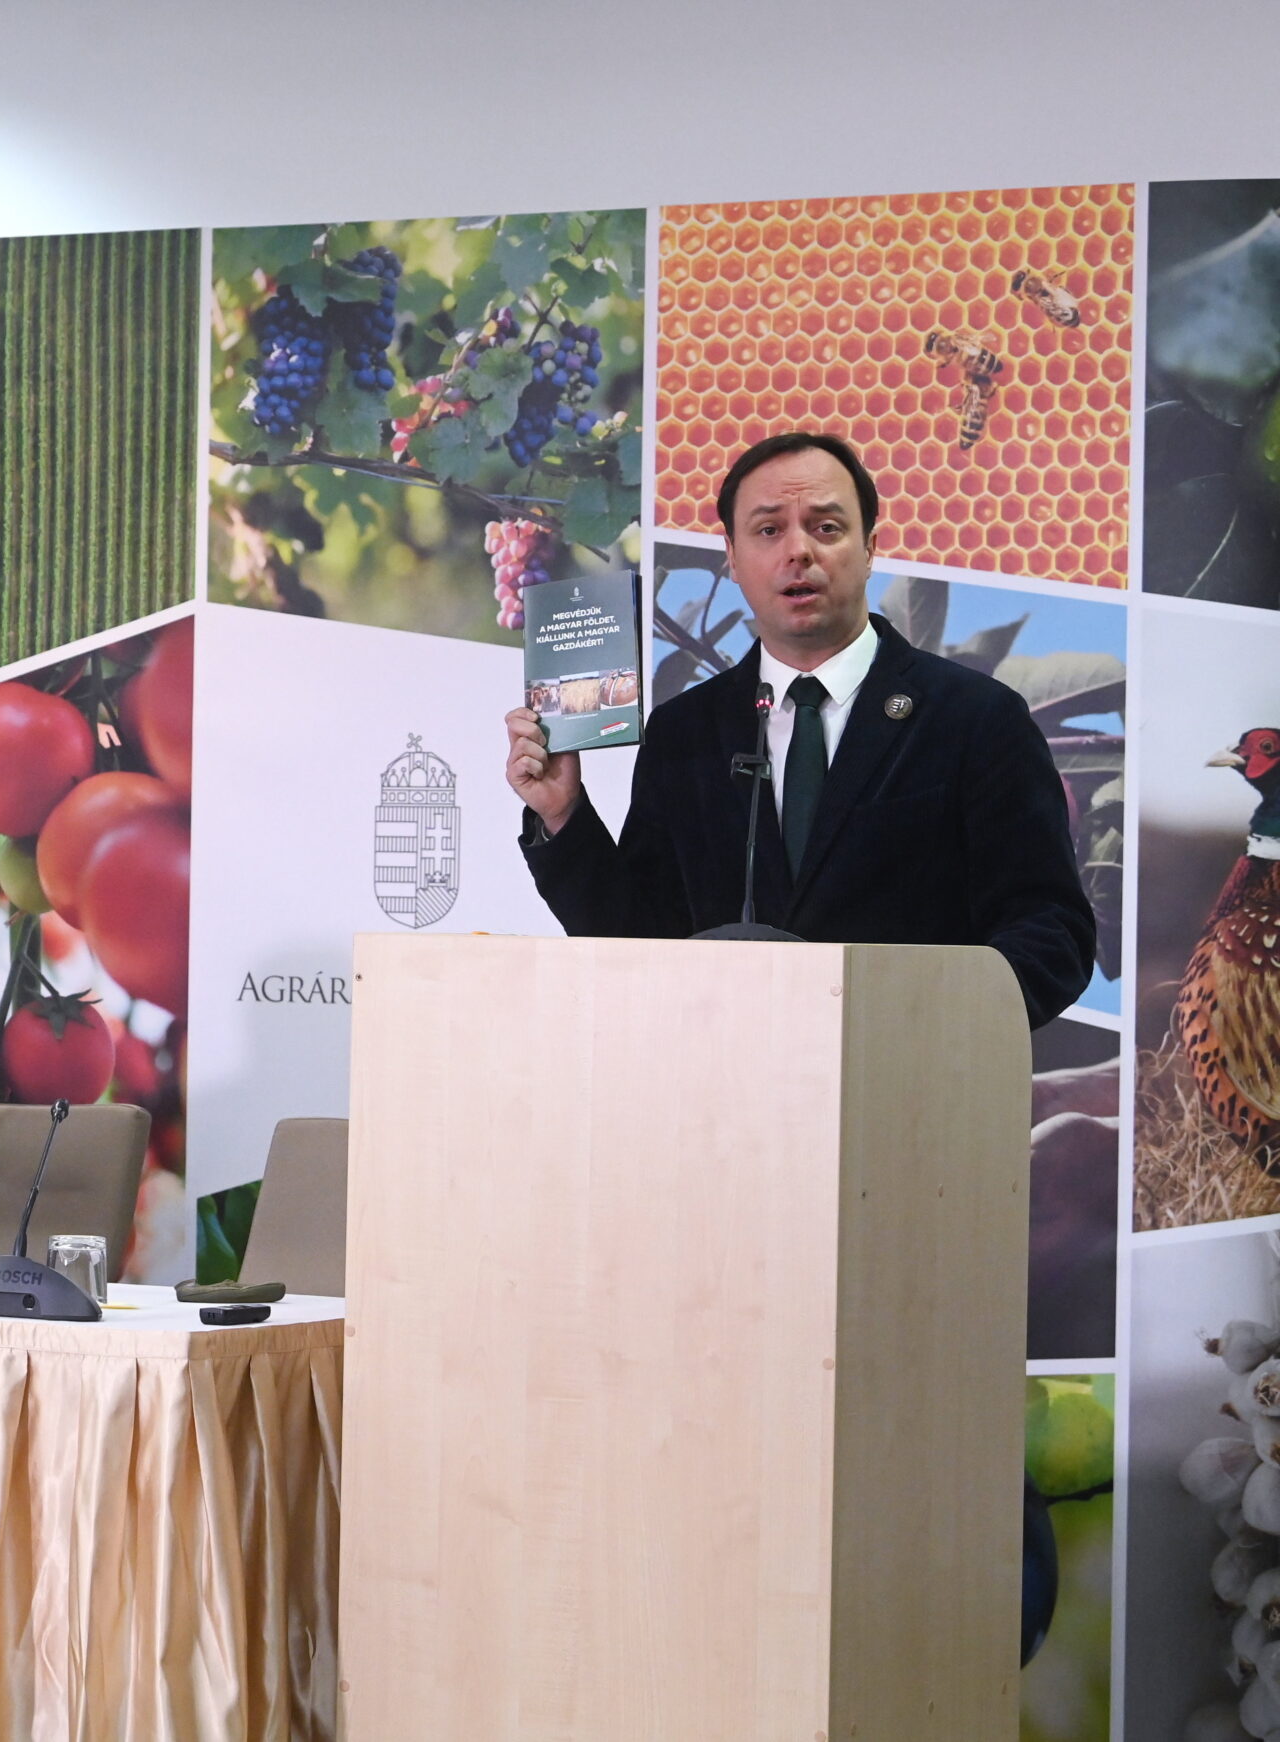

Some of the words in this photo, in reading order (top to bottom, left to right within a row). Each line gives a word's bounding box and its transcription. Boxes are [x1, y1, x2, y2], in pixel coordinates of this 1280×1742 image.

[552, 606, 602, 621] MEGVÉDJÜK
[547, 620, 582, 632] MAGYAR
[583, 615, 616, 627] FÖLDET,
[536, 631, 576, 644] KIÁLLUNK
[584, 625, 620, 637] MAGYAR
[552, 637, 604, 652] GAZDÁKÉRT!
